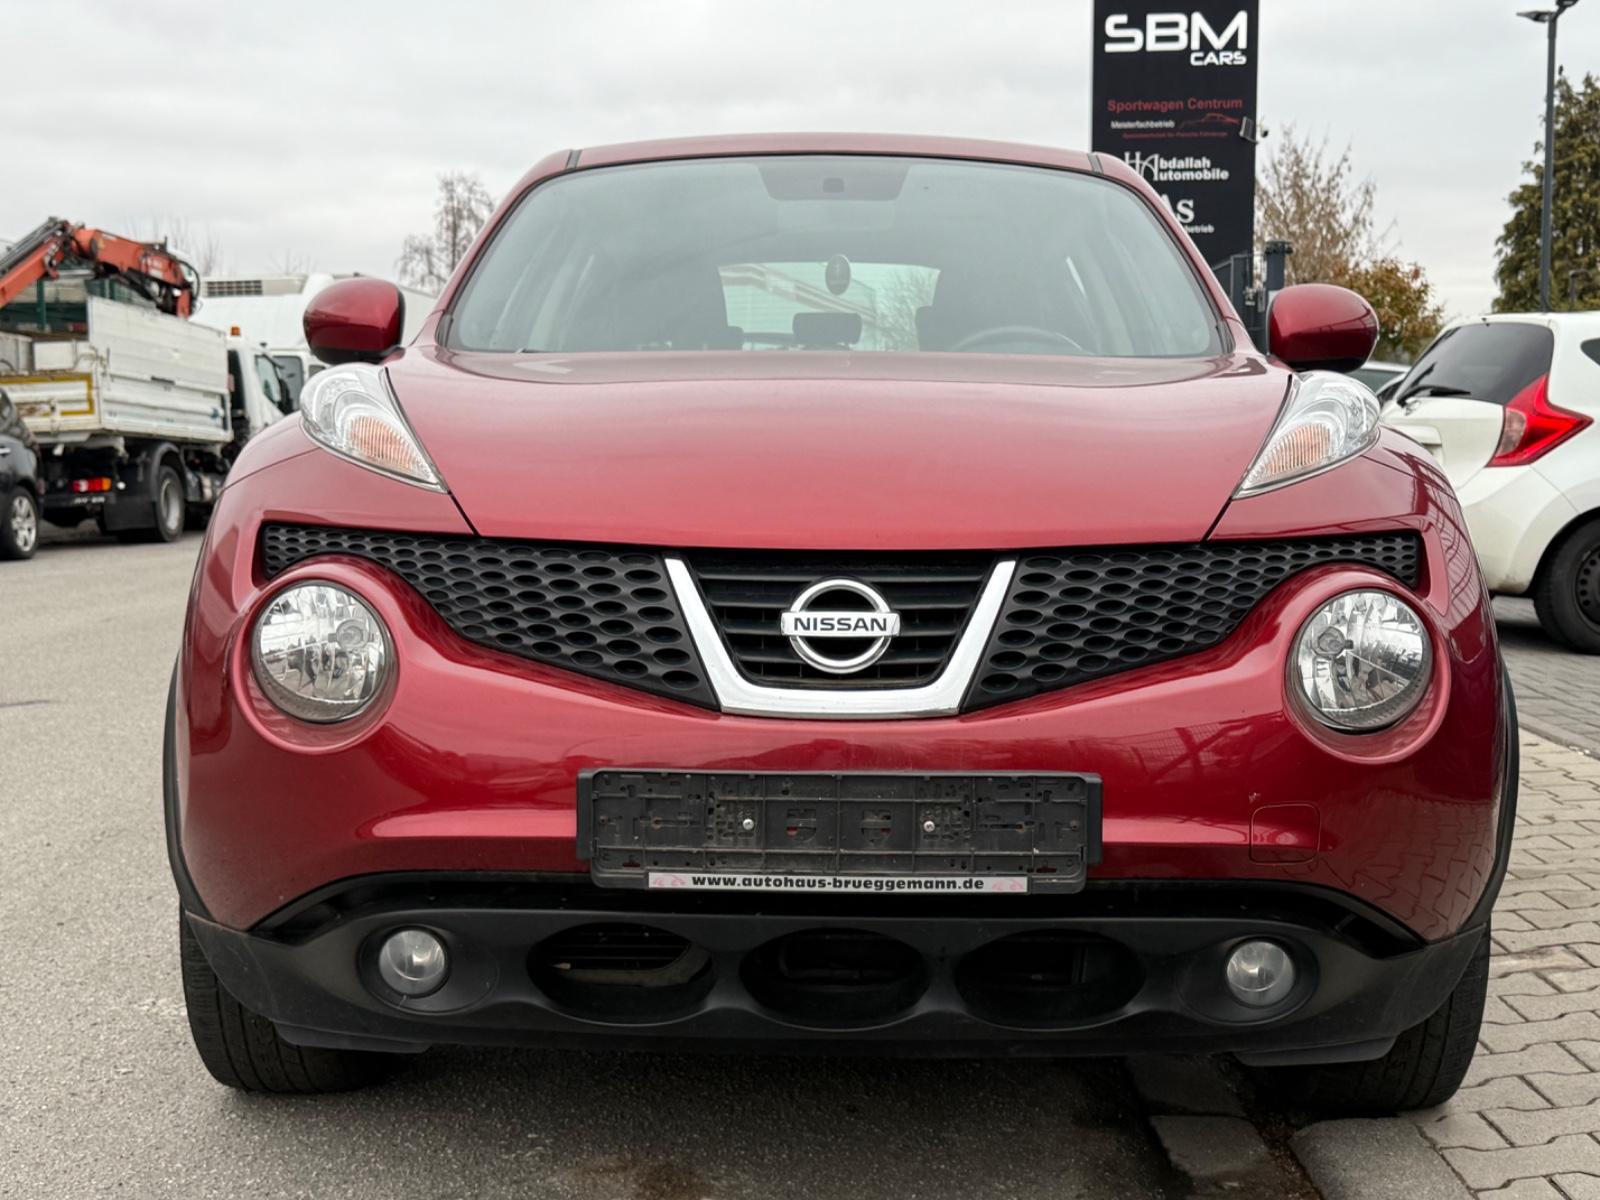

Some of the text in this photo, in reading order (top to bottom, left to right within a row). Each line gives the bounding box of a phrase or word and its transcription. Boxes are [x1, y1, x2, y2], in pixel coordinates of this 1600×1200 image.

[1104, 11, 1248, 53] SBM
[1190, 51, 1247, 66] CARS
[1107, 98, 1243, 112] Sportwagen Centrum
[794, 617, 887, 632] NISSAN
[691, 875, 984, 891] www.autohaus-brueggemann.de
